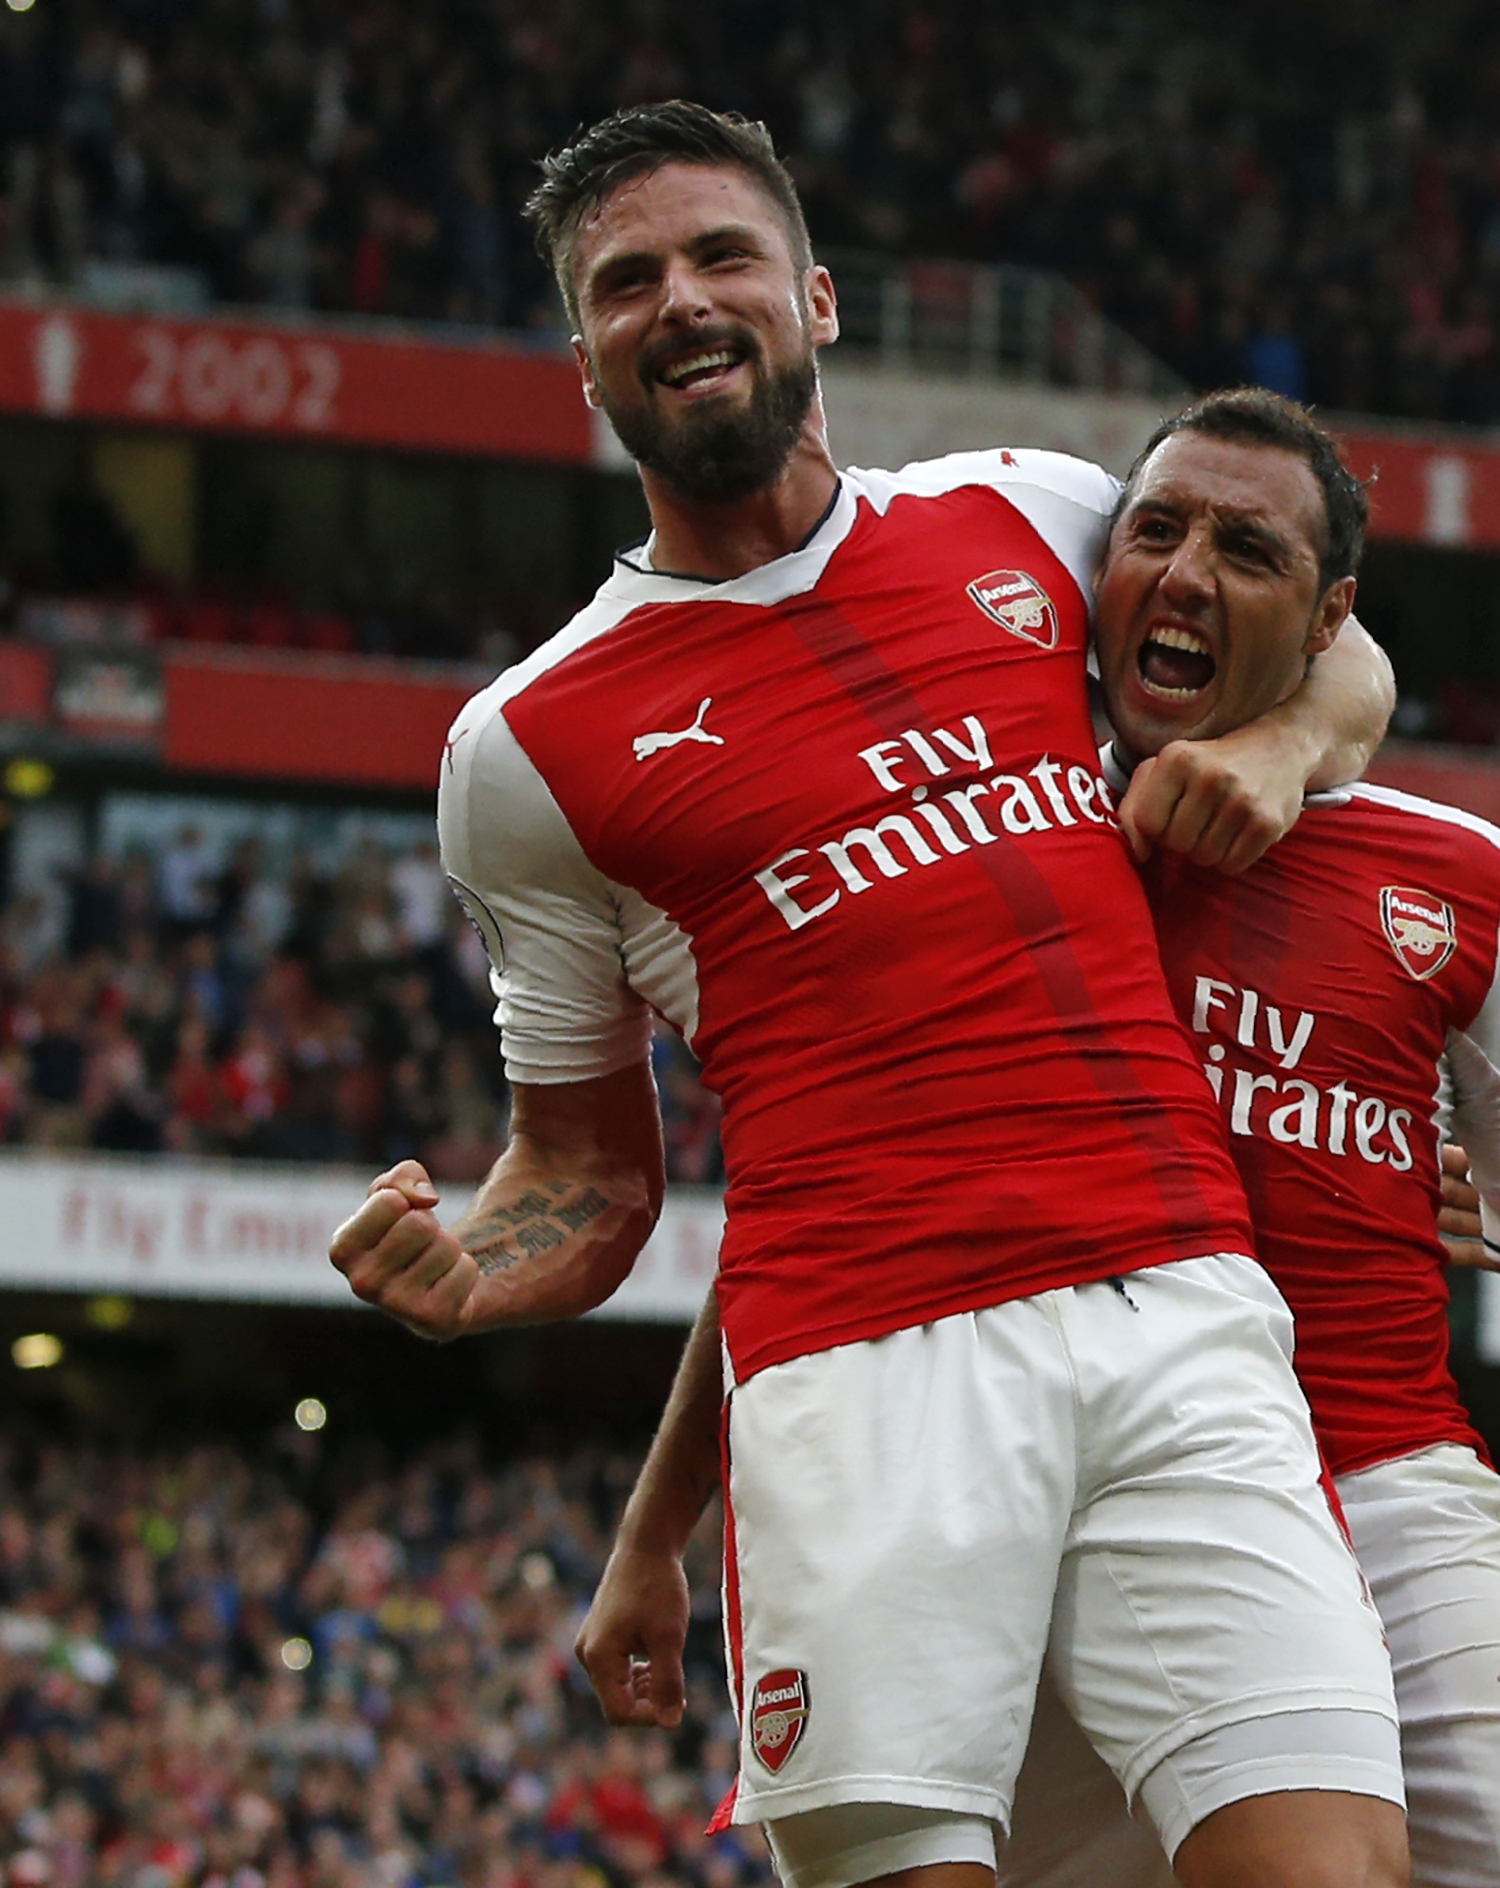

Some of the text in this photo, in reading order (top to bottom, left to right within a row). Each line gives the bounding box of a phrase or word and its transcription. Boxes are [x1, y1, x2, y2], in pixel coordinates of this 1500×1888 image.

[128, 333, 342, 428] 2002
[980, 581, 1035, 602] Arsenal
[857, 715, 994, 793] Fly
[1391, 896, 1446, 926] Arsenal
[1193, 976, 1315, 1069] Fly
